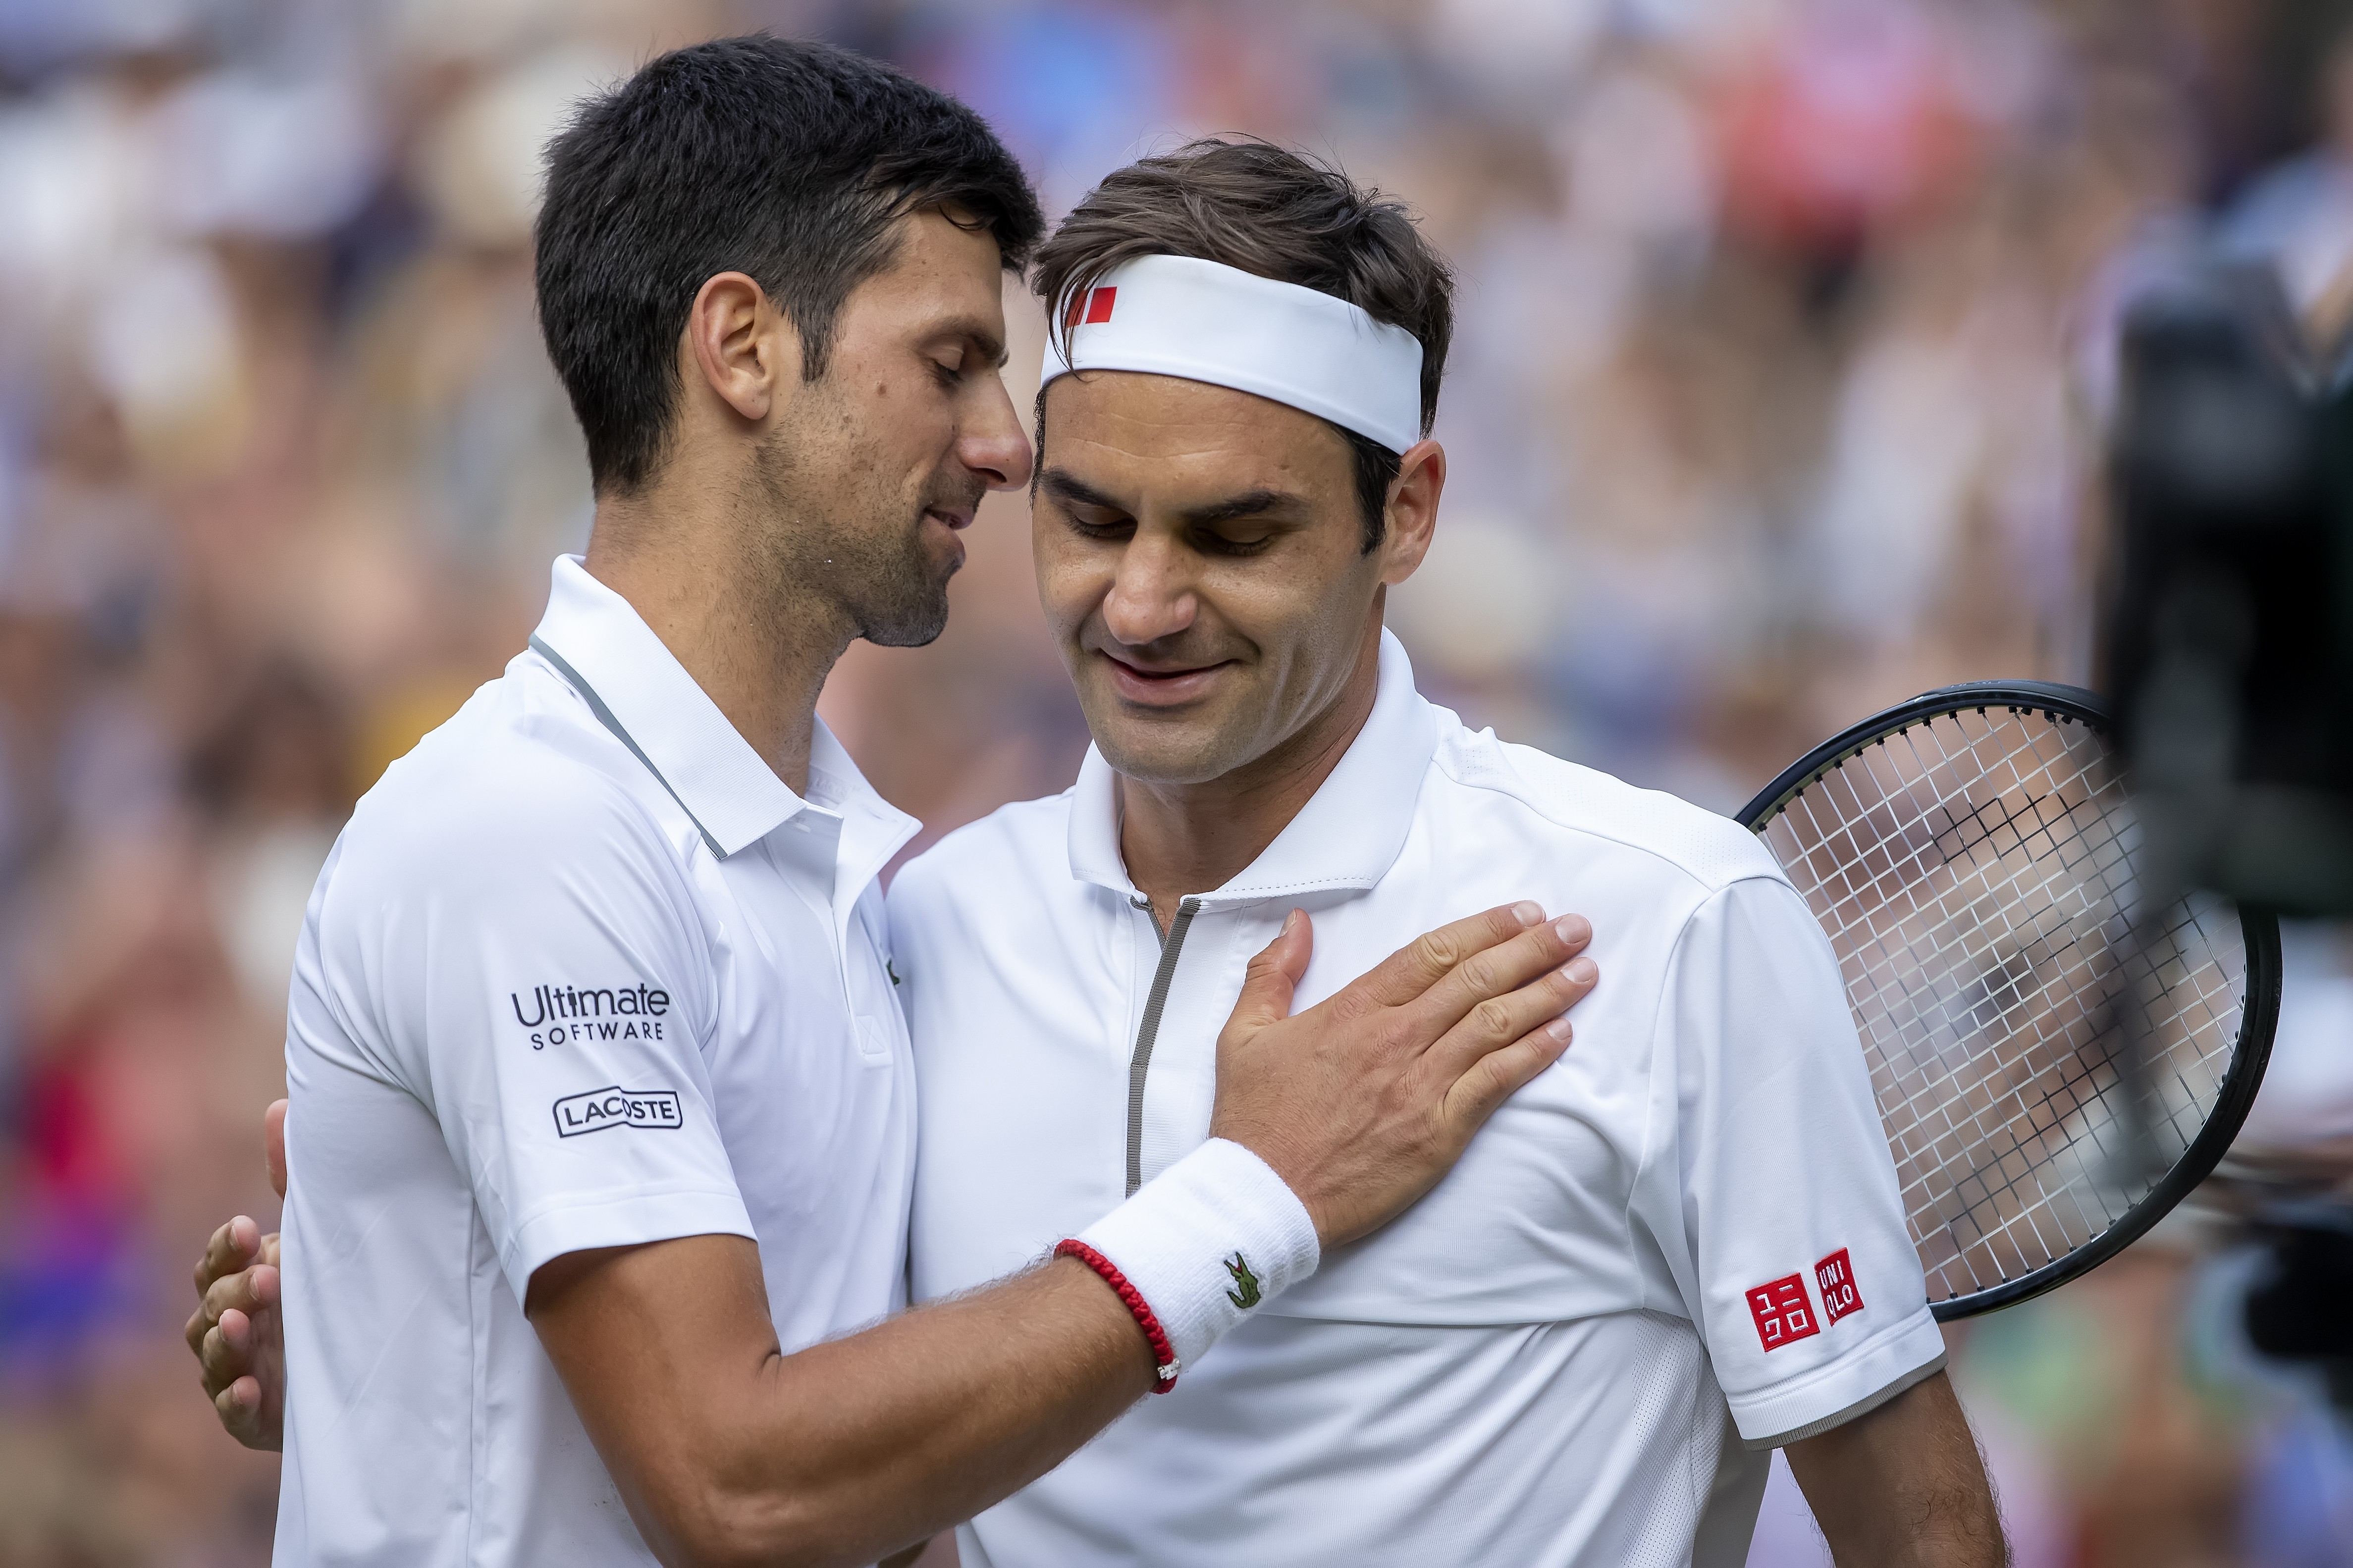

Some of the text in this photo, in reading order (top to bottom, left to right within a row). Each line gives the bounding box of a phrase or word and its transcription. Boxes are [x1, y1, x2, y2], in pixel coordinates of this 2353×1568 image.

[511, 983, 670, 1027] Ultimate
[531, 1021, 663, 1050] SOFTWARE
[564, 1097, 675, 1126] LACOSTE
[1819, 1259, 1844, 1290] UNI
[1826, 1284, 1854, 1318] QLO
